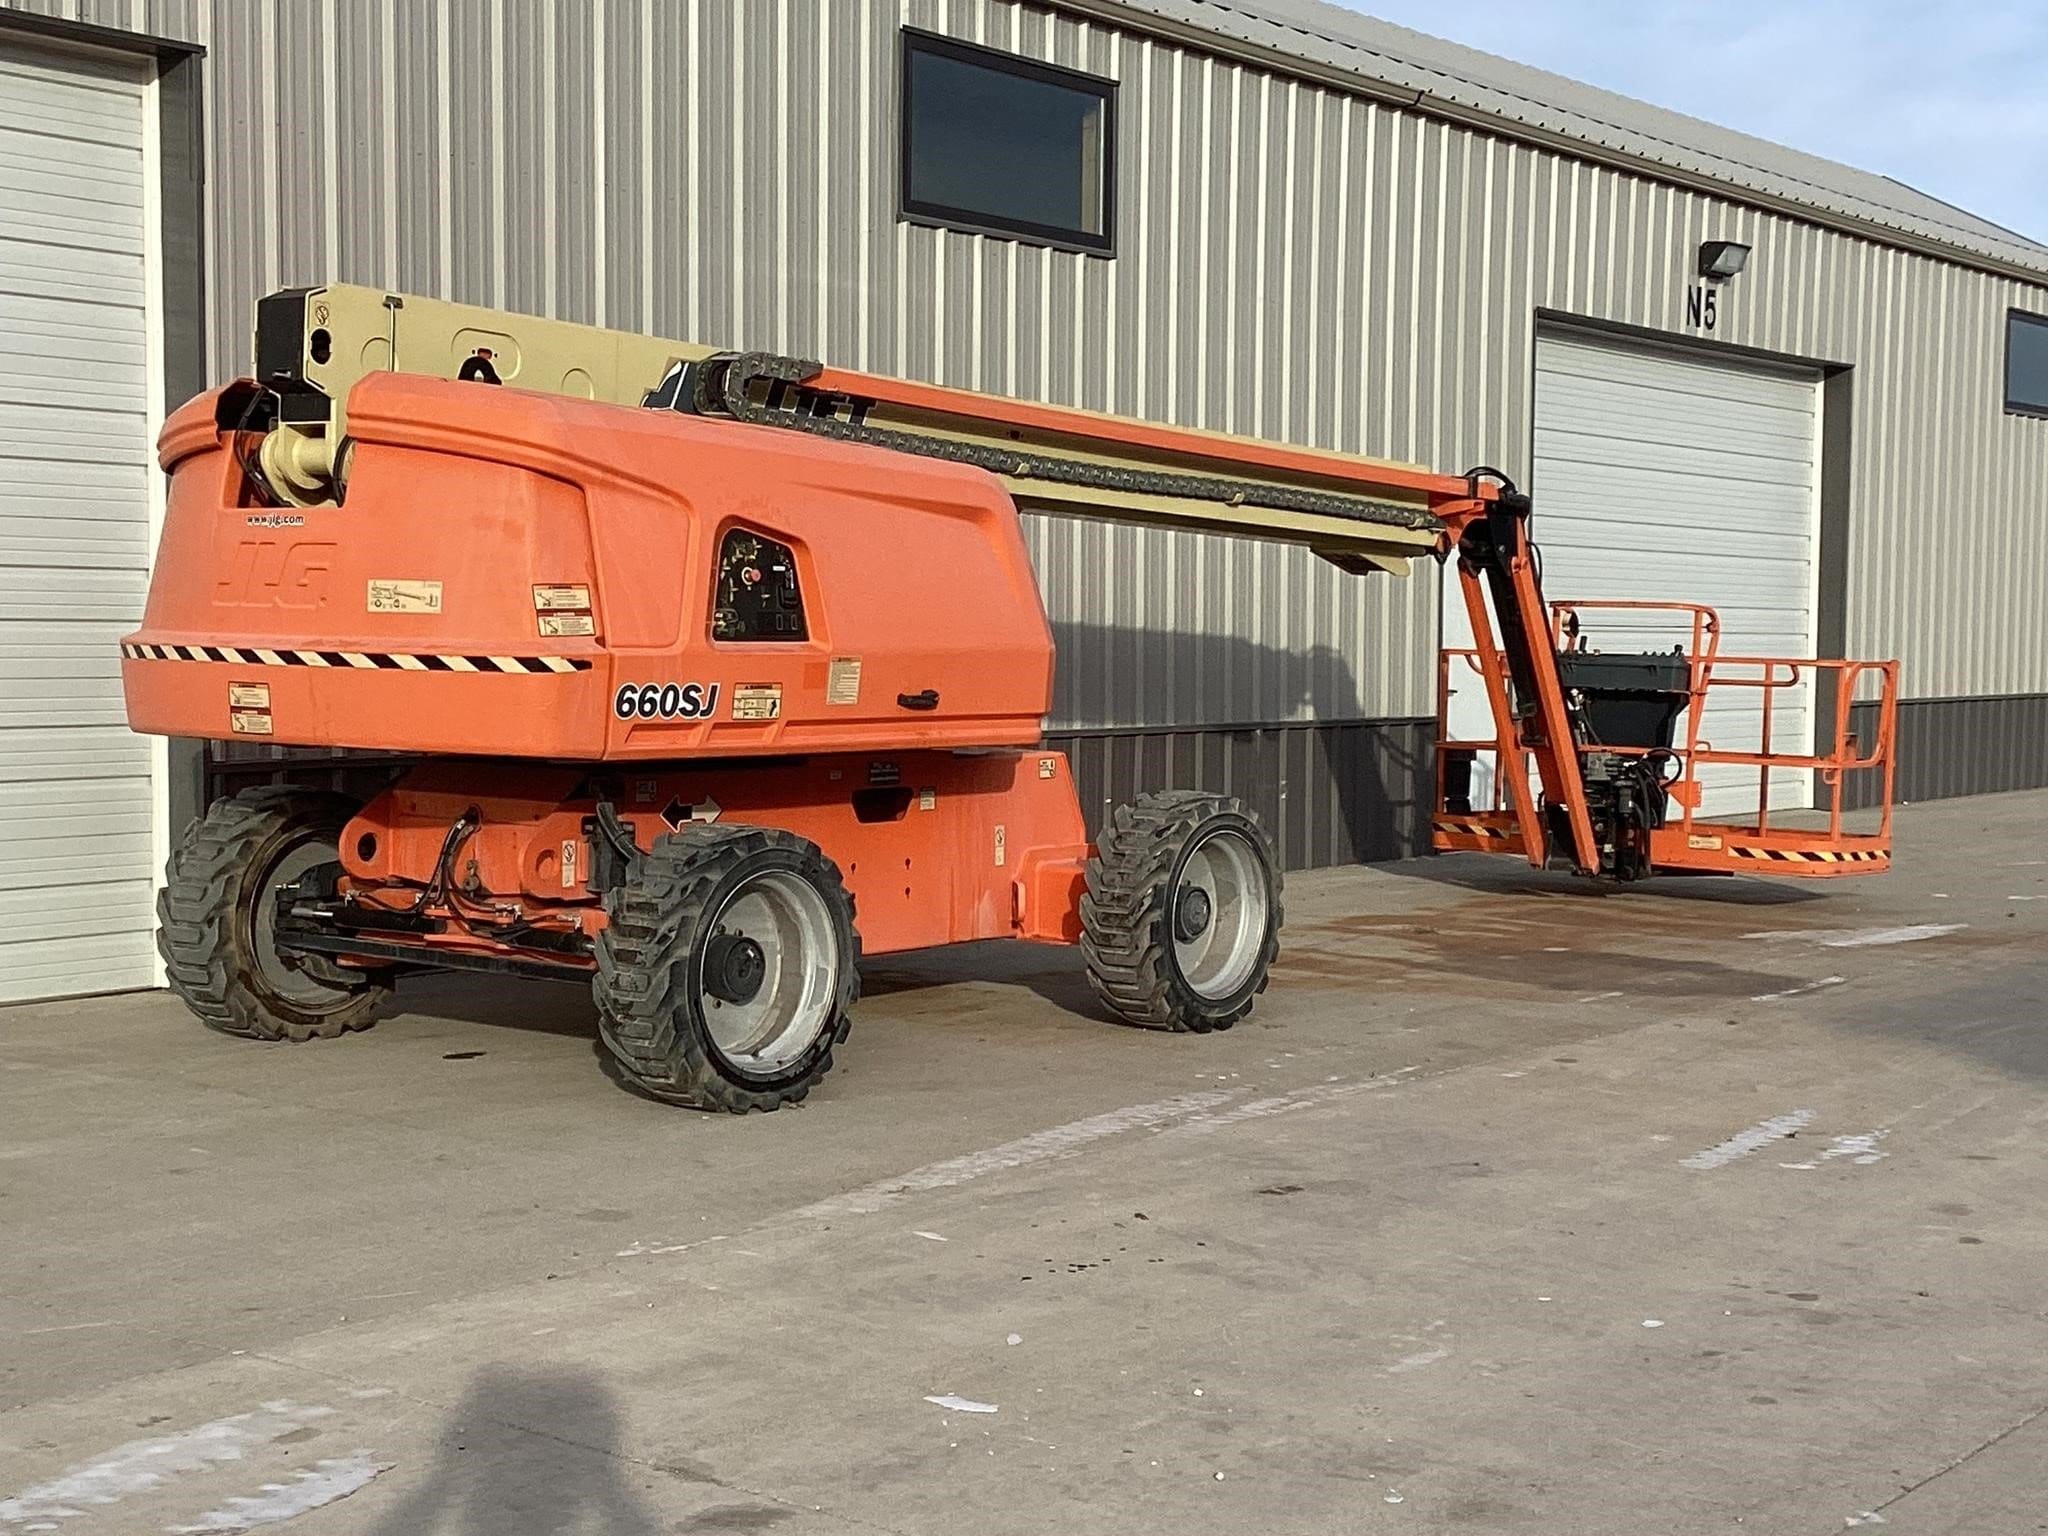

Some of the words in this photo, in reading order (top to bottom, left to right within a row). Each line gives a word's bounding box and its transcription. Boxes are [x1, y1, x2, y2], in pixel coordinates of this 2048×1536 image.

[1686, 285, 1716, 330] N5
[247, 514, 304, 527] www.jlg.com
[615, 683, 720, 719] 660SJ
